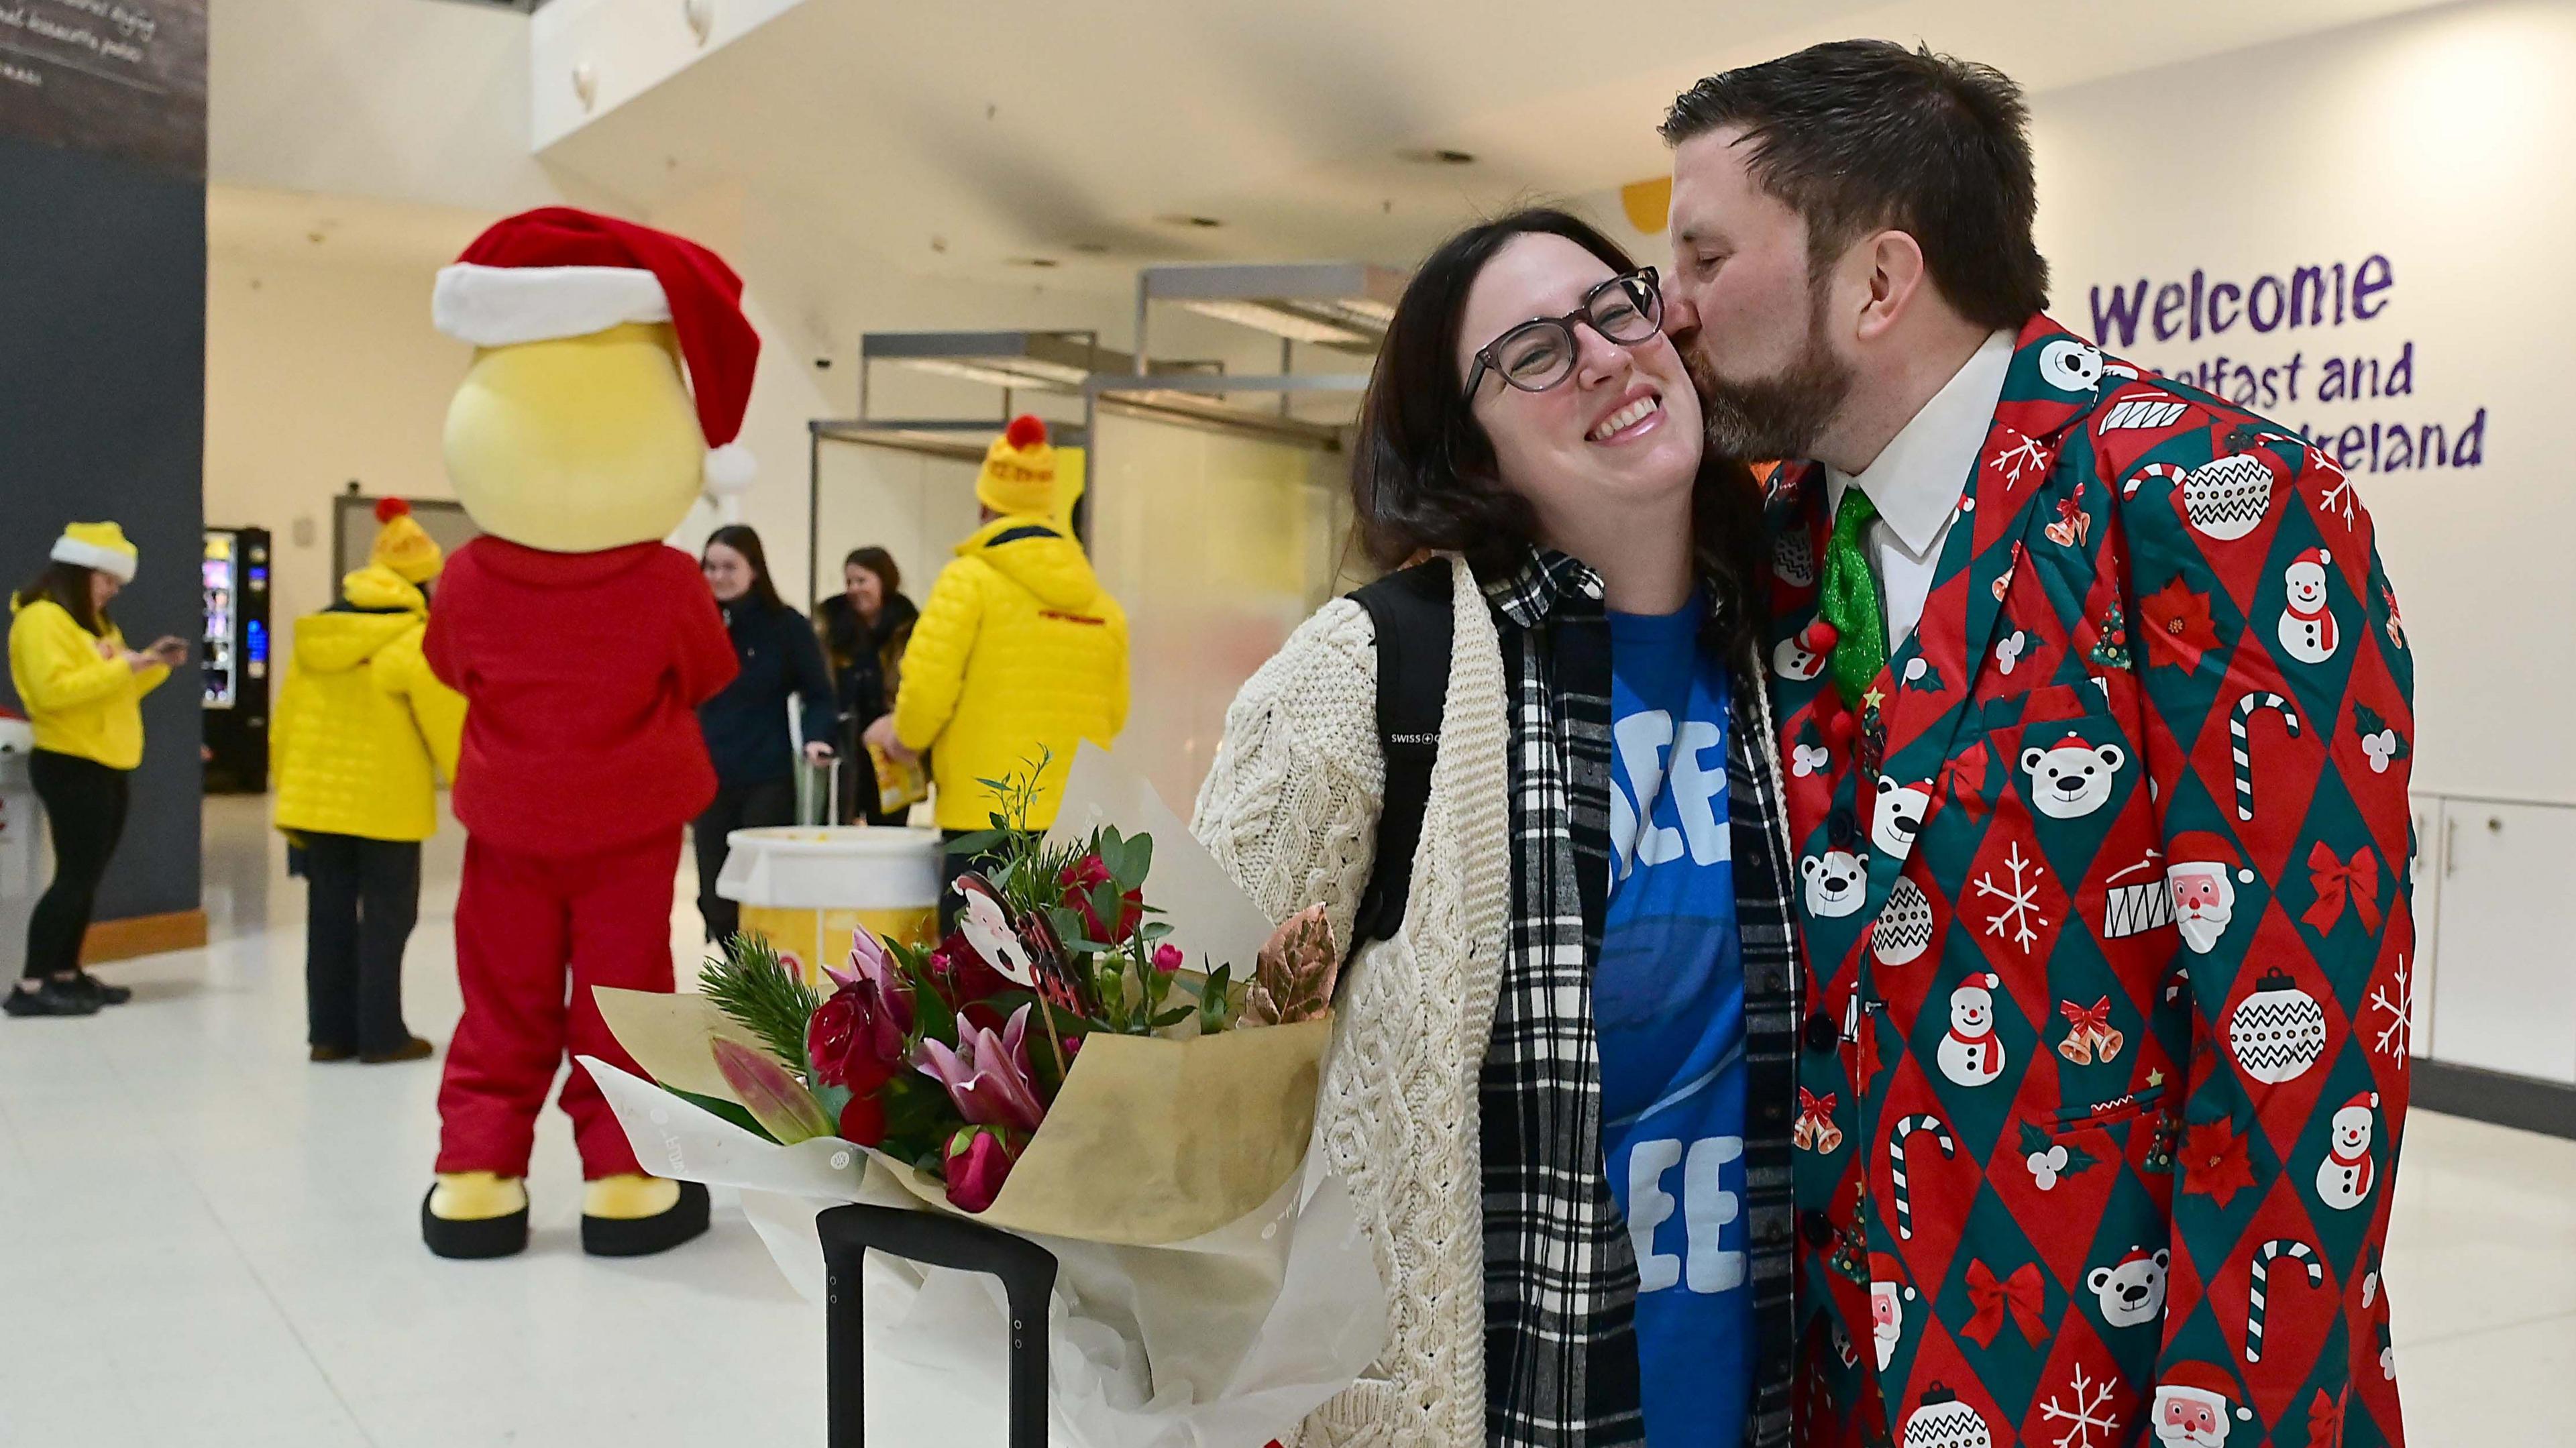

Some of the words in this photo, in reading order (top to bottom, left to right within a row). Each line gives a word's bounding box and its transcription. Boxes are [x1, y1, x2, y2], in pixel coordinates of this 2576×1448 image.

[2090, 254, 2393, 347] Welcome
[2318, 341, 2414, 402] and
[1391, 733, 1421, 743] SWISS
